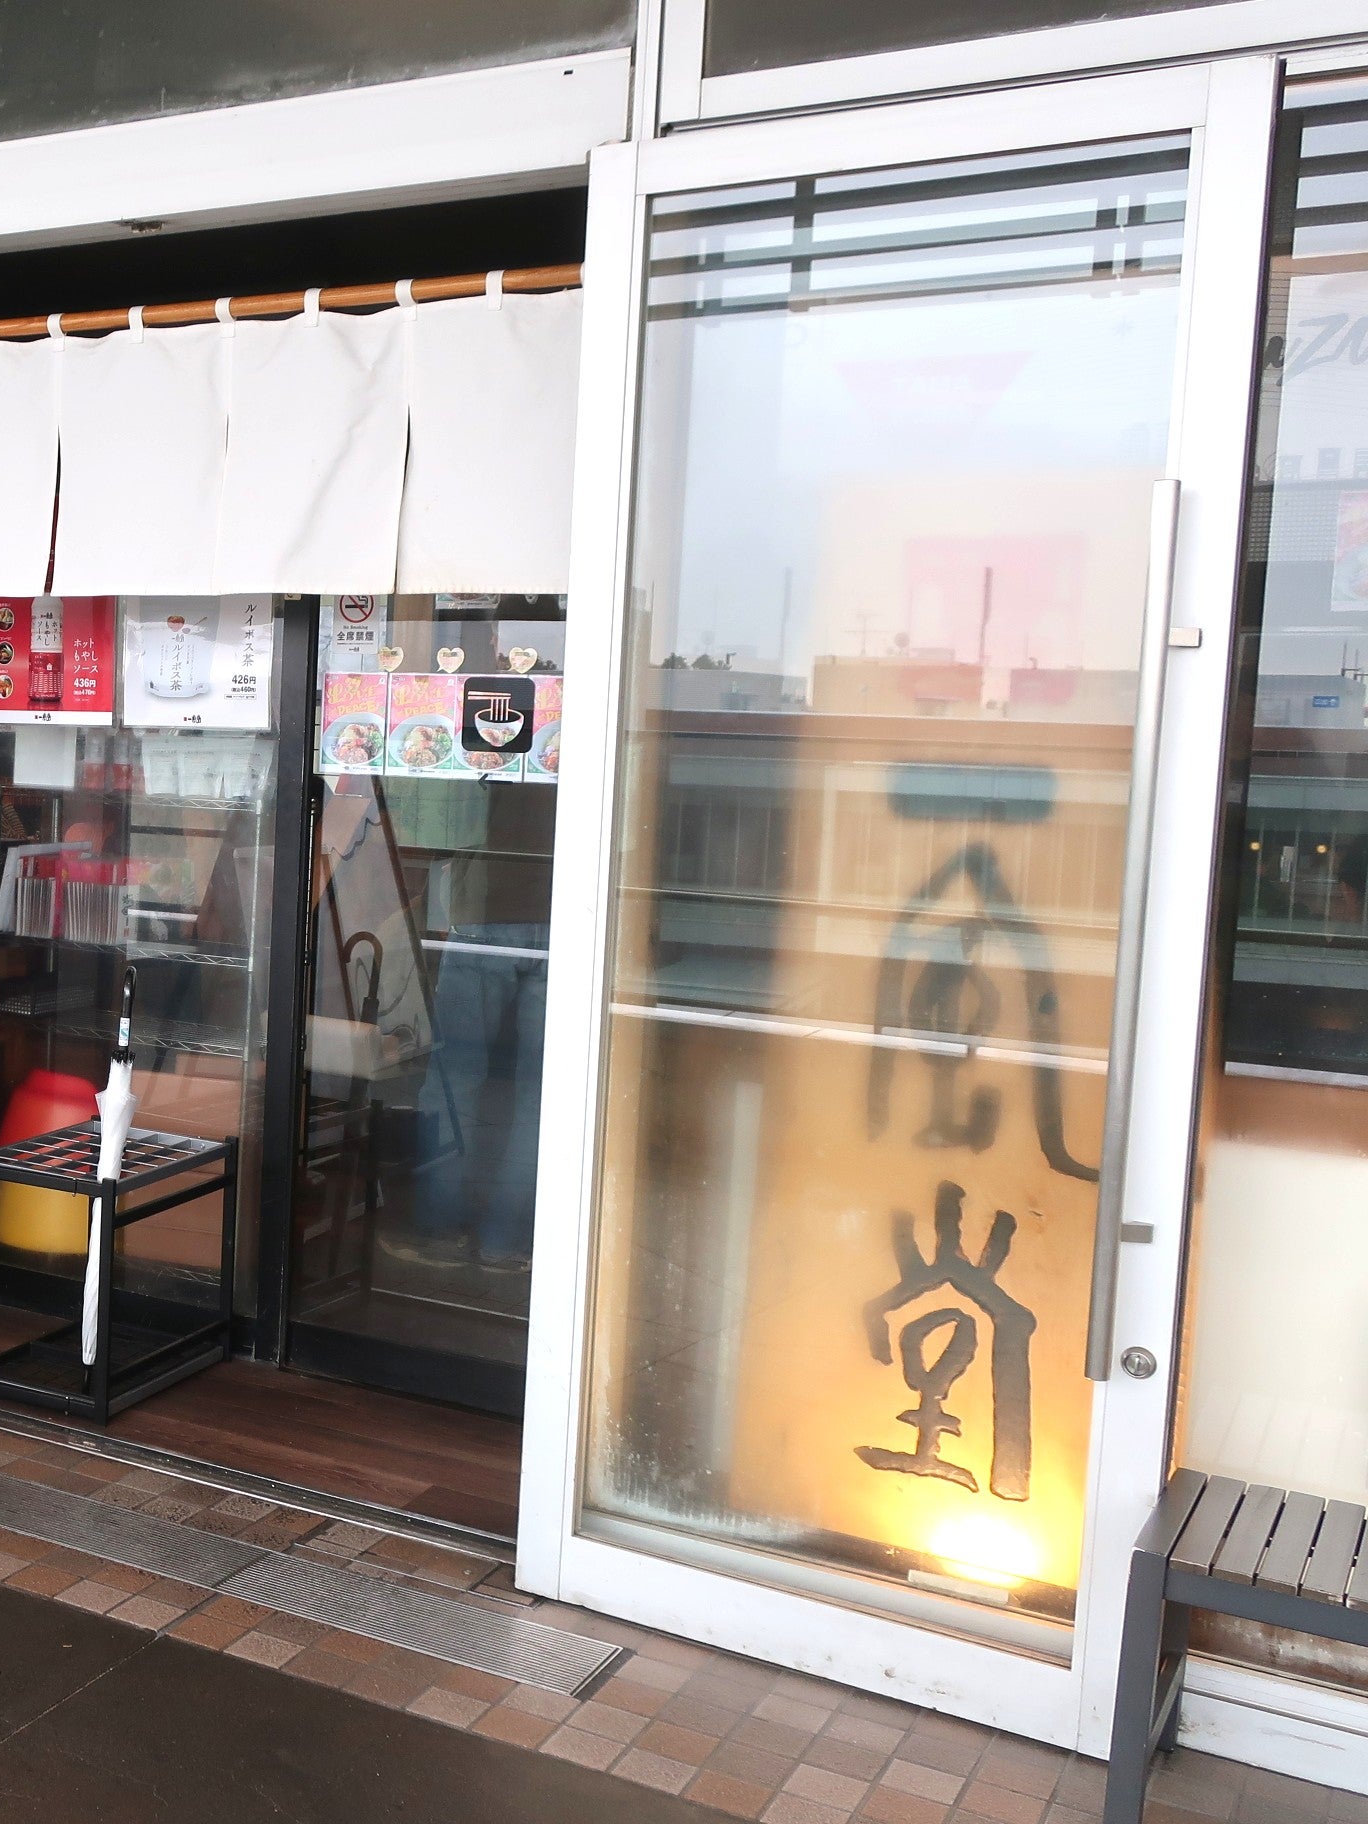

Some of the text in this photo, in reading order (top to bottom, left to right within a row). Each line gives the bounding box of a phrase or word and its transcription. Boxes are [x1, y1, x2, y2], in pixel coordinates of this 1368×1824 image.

[337, 631, 374, 641] 全席禁煙
[73, 637, 95, 649] ホット
[73, 650, 99, 662] もやし
[73, 664, 99, 674] ソース
[73, 678, 96, 688] 436円
[231, 674, 256, 684] 426円
